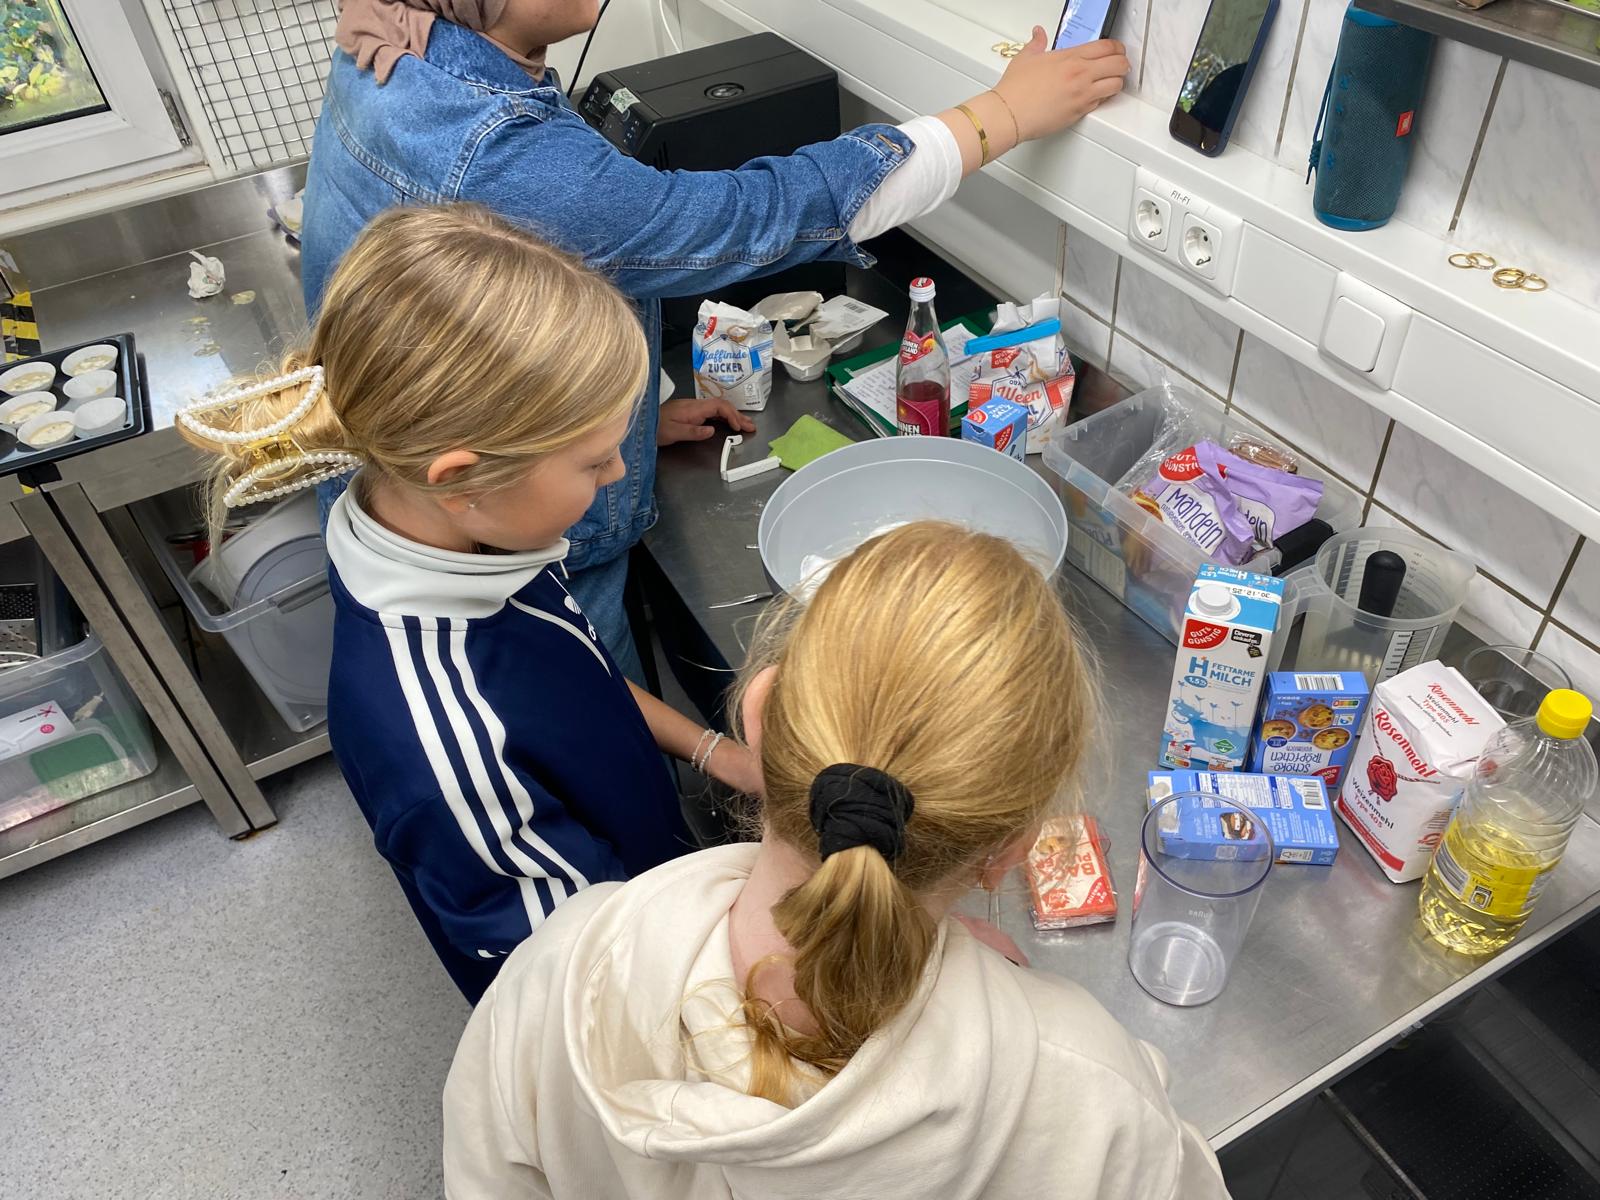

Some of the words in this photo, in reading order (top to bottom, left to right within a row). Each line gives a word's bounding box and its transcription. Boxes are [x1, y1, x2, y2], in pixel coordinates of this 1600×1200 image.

[708, 363, 744, 373] ZUCKER
[1166, 487, 1223, 549] Mandeln
[1187, 627, 1222, 645] GÜNSTIG
[1188, 656, 1210, 677] H
[1212, 662, 1256, 678] FETTARME
[1210, 670, 1252, 687] MILCH
[1423, 699, 1437, 713] Type
[1437, 712, 1451, 723] 405
[1427, 683, 1480, 725] Rosenmehl
[1427, 693, 1459, 723] Weizenmehl
[1374, 708, 1438, 778] Rosenmehl
[1352, 777, 1394, 829] Weizenmehl
[1353, 793, 1369, 814] Type
[1368, 811, 1384, 829] 405
